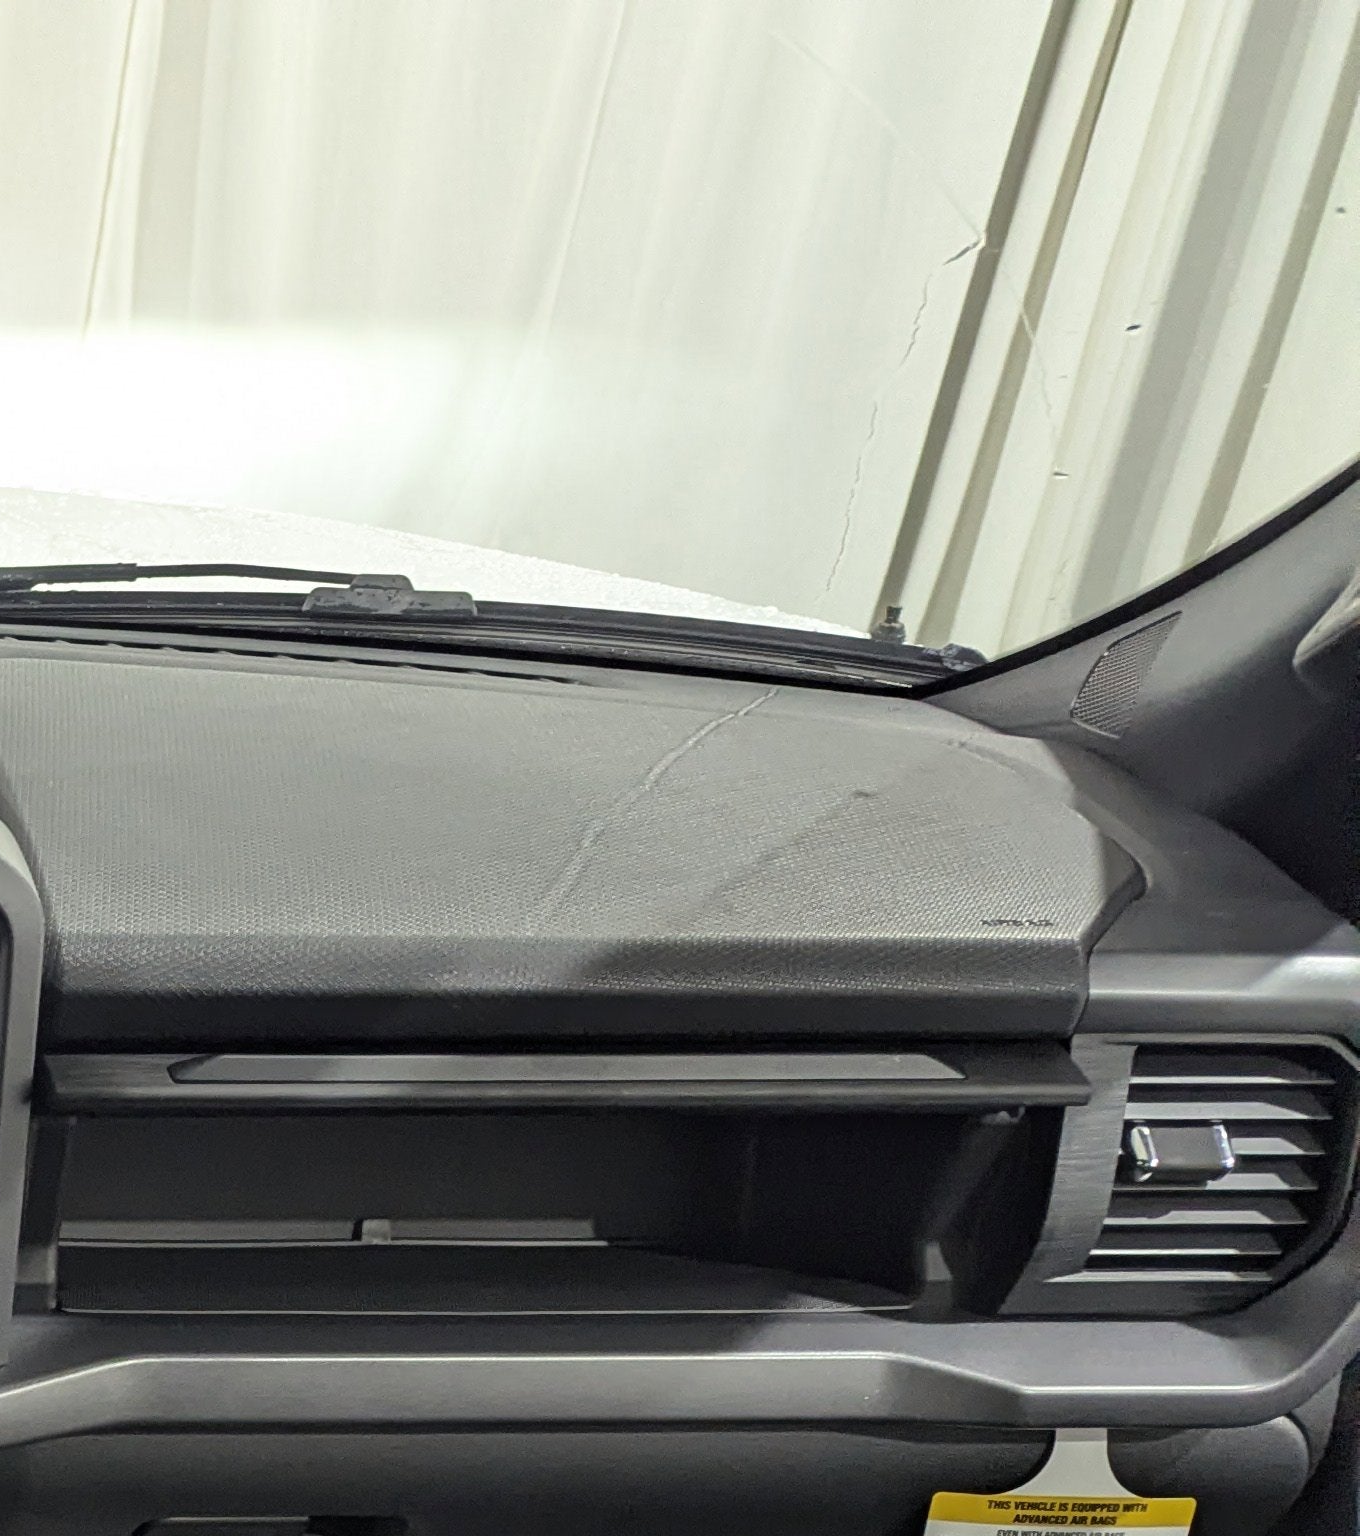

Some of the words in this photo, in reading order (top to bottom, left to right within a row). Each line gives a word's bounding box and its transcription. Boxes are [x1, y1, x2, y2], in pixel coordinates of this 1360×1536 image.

[987, 1500, 1011, 1511] THIS
[1014, 1501, 1056, 1512] VEHICLE
[1058, 1502, 1069, 1512] IS
[1071, 1502, 1120, 1513] EQUIPPED
[1123, 1503, 1148, 1513] WITH
[1013, 1514, 1067, 1524] ADVANCED
[1070, 1515, 1087, 1525] AIR
[1090, 1515, 1117, 1526] BAGS
